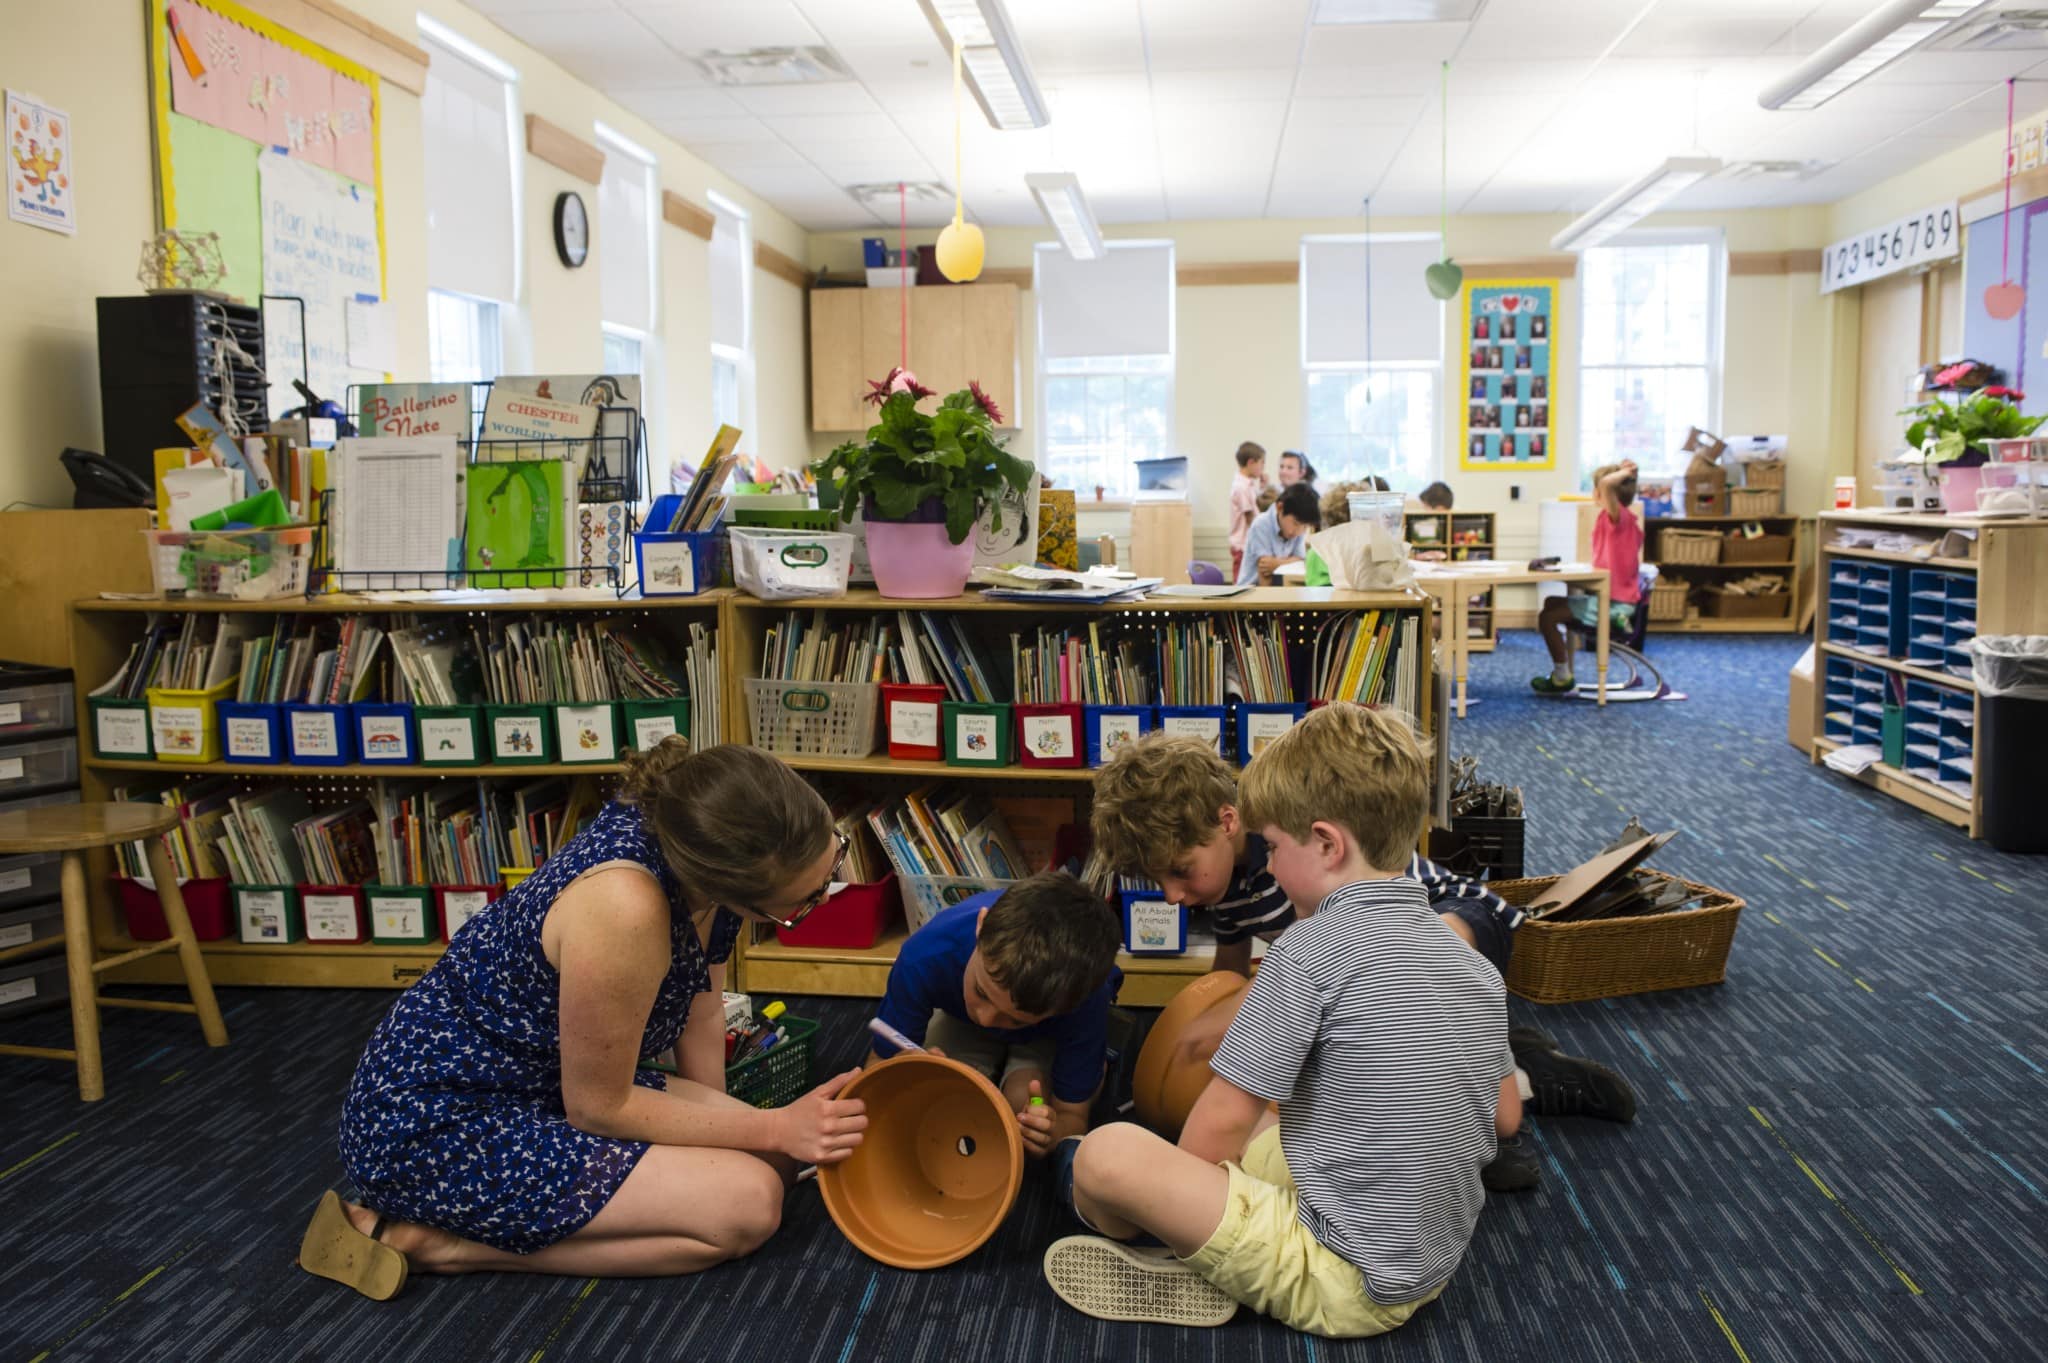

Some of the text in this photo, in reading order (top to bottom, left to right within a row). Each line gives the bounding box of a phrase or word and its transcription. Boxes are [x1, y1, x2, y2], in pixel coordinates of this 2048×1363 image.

[363, 394, 457, 423] Ballerino
[506, 402, 579, 424] CHESTER
[383, 416, 440, 437] Nate
[492, 422, 557, 440] WORLDLY
[1135, 906, 1177, 915] All About
[1137, 916, 1171, 926] Animals
